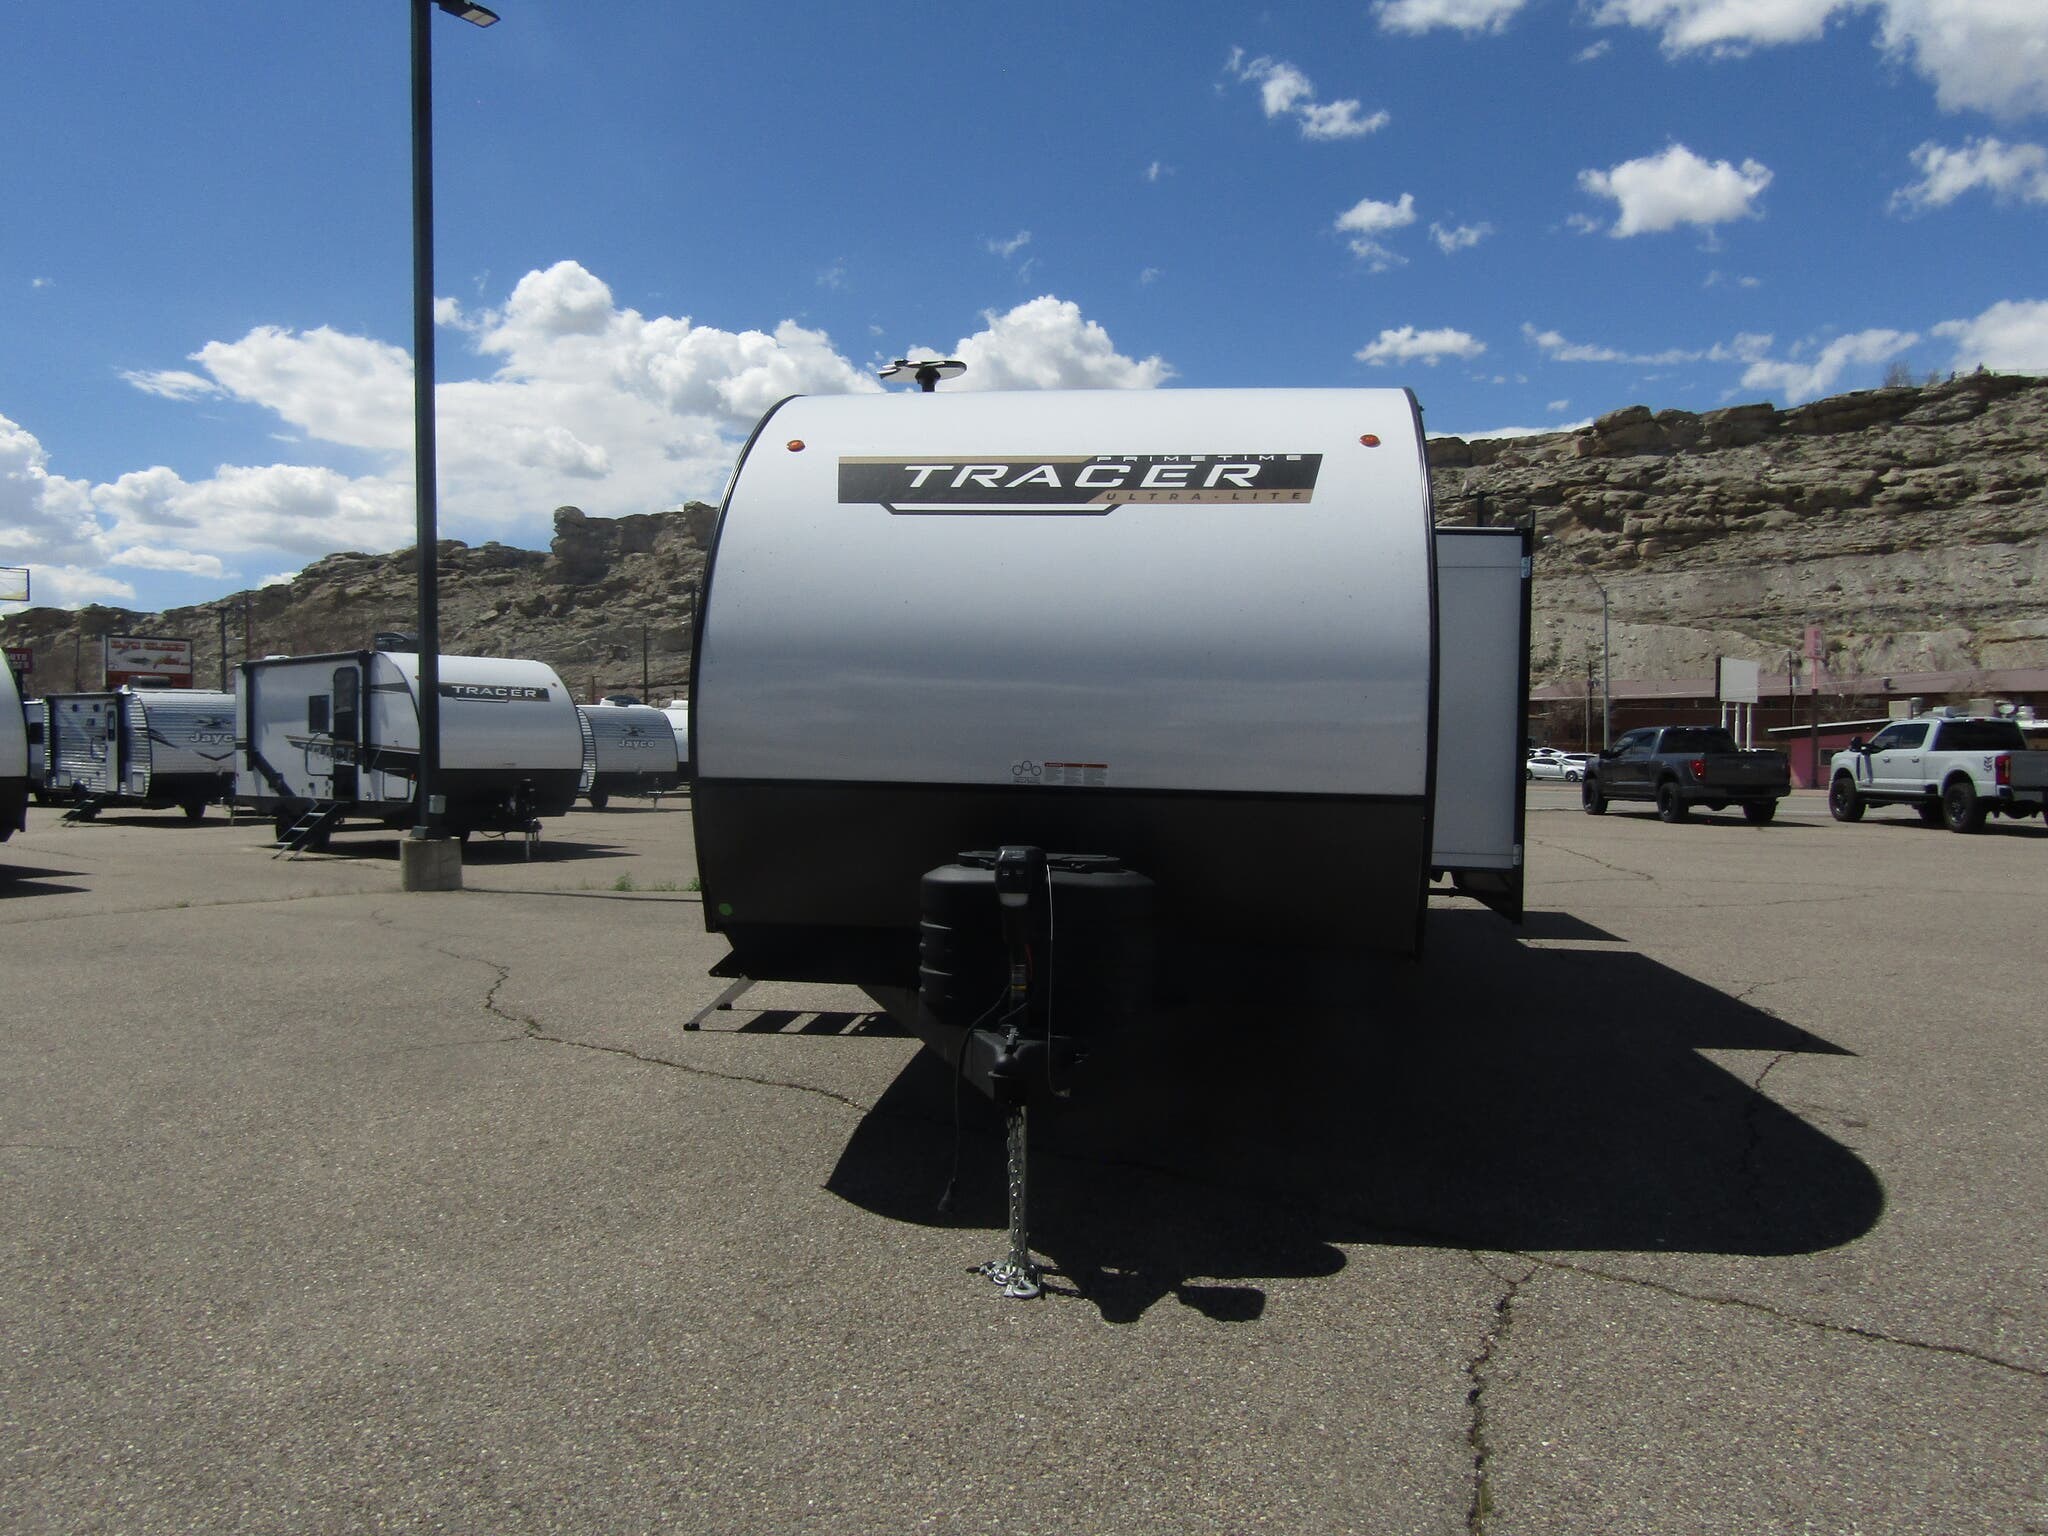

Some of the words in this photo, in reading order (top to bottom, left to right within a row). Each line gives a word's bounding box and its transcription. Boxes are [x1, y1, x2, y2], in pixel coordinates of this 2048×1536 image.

[904, 464, 1262, 488] TRACER
[1106, 492, 1302, 501] ULTRA-LITE
[451, 685, 537, 698] TRACER
[190, 732, 234, 745] Jayc
[619, 739, 655, 749] Jayco
